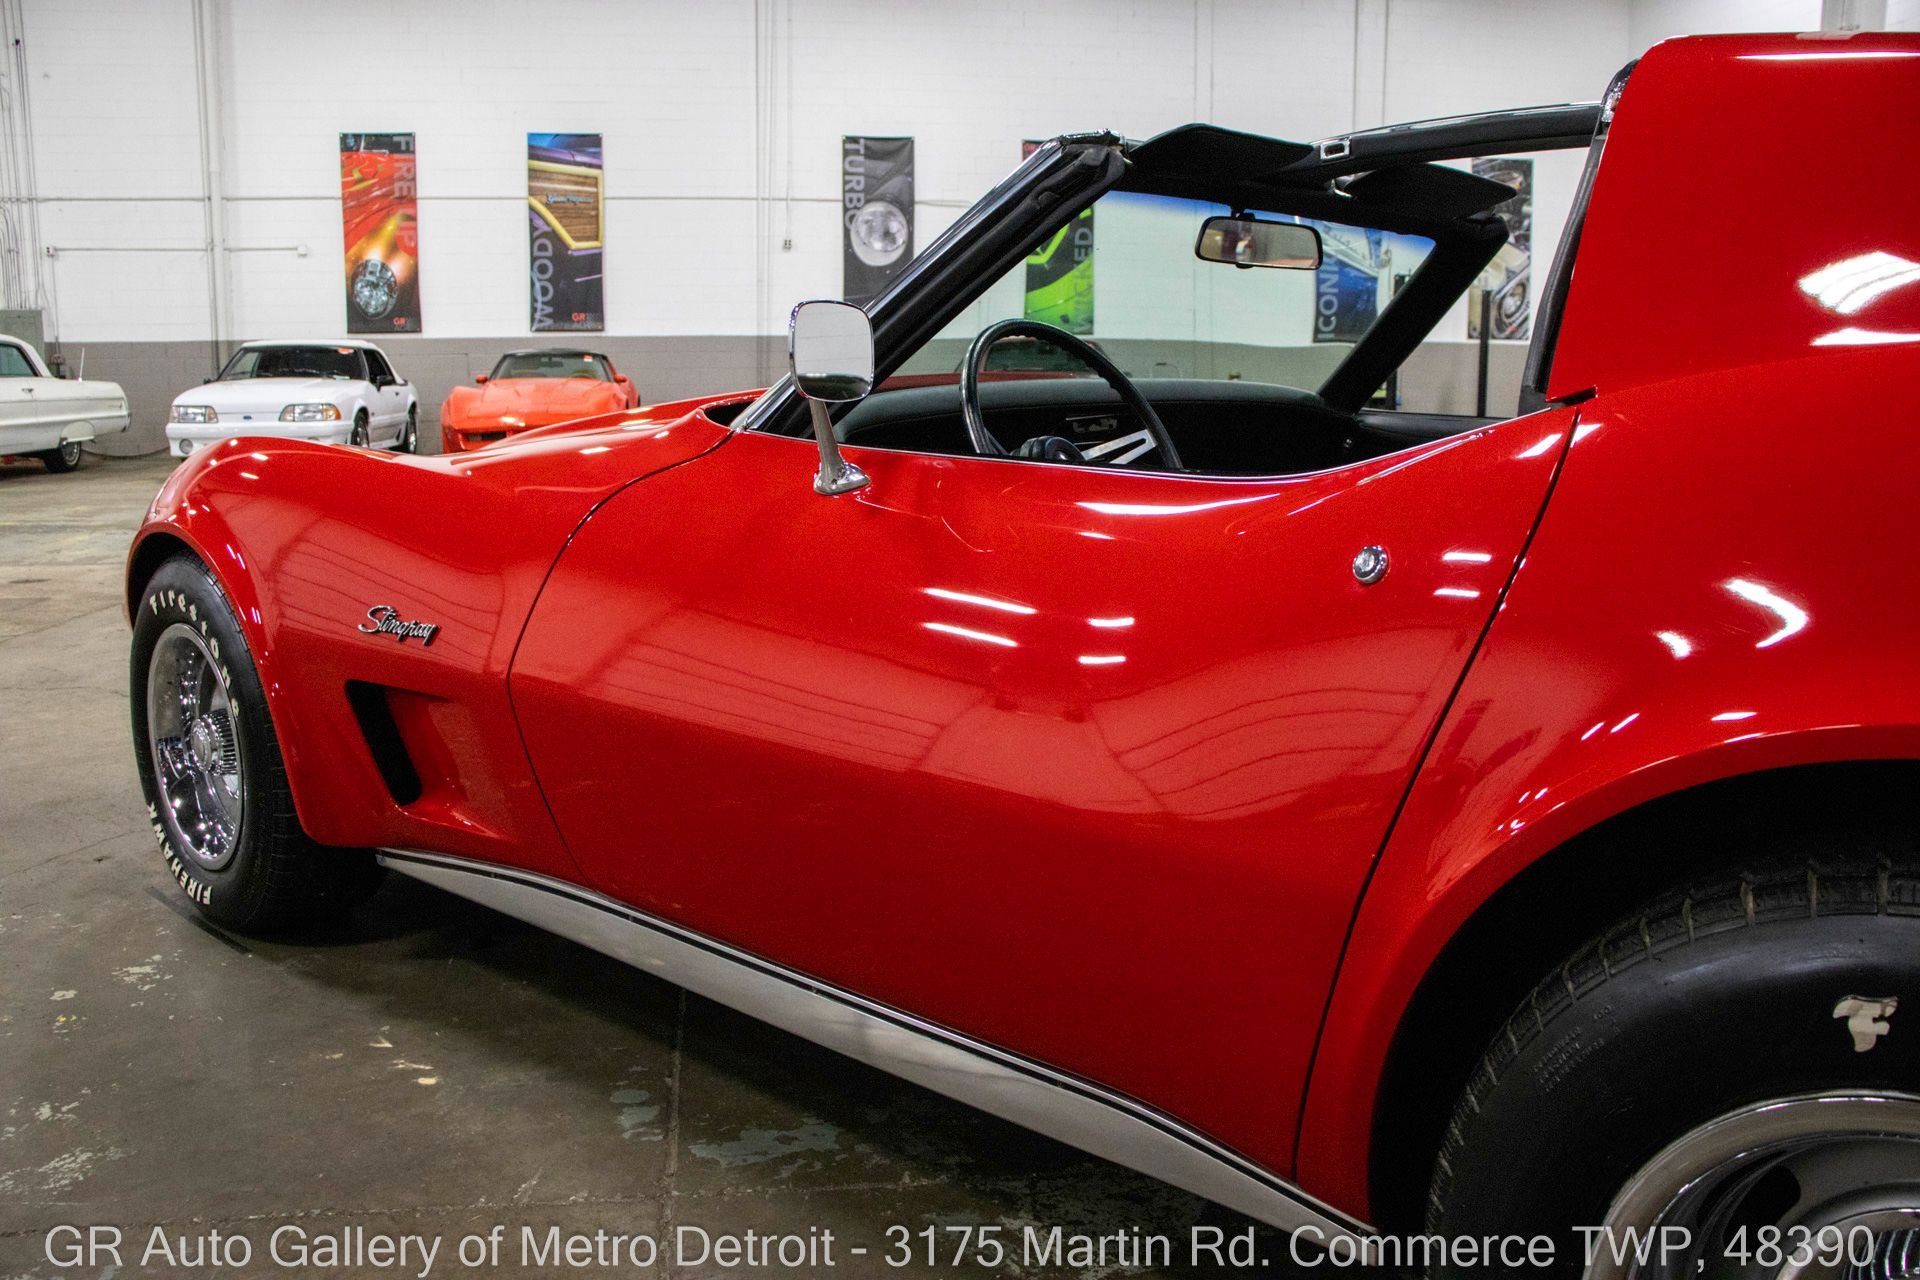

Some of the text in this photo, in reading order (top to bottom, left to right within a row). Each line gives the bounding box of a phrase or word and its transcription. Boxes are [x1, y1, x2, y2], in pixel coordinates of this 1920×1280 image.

[392, 136, 417, 248] FIRE UP
[844, 138, 865, 229] TURBO
[533, 217, 554, 329] WOODY
[358, 604, 437, 646] Stingray
[147, 801, 213, 905] FIREHAWK
